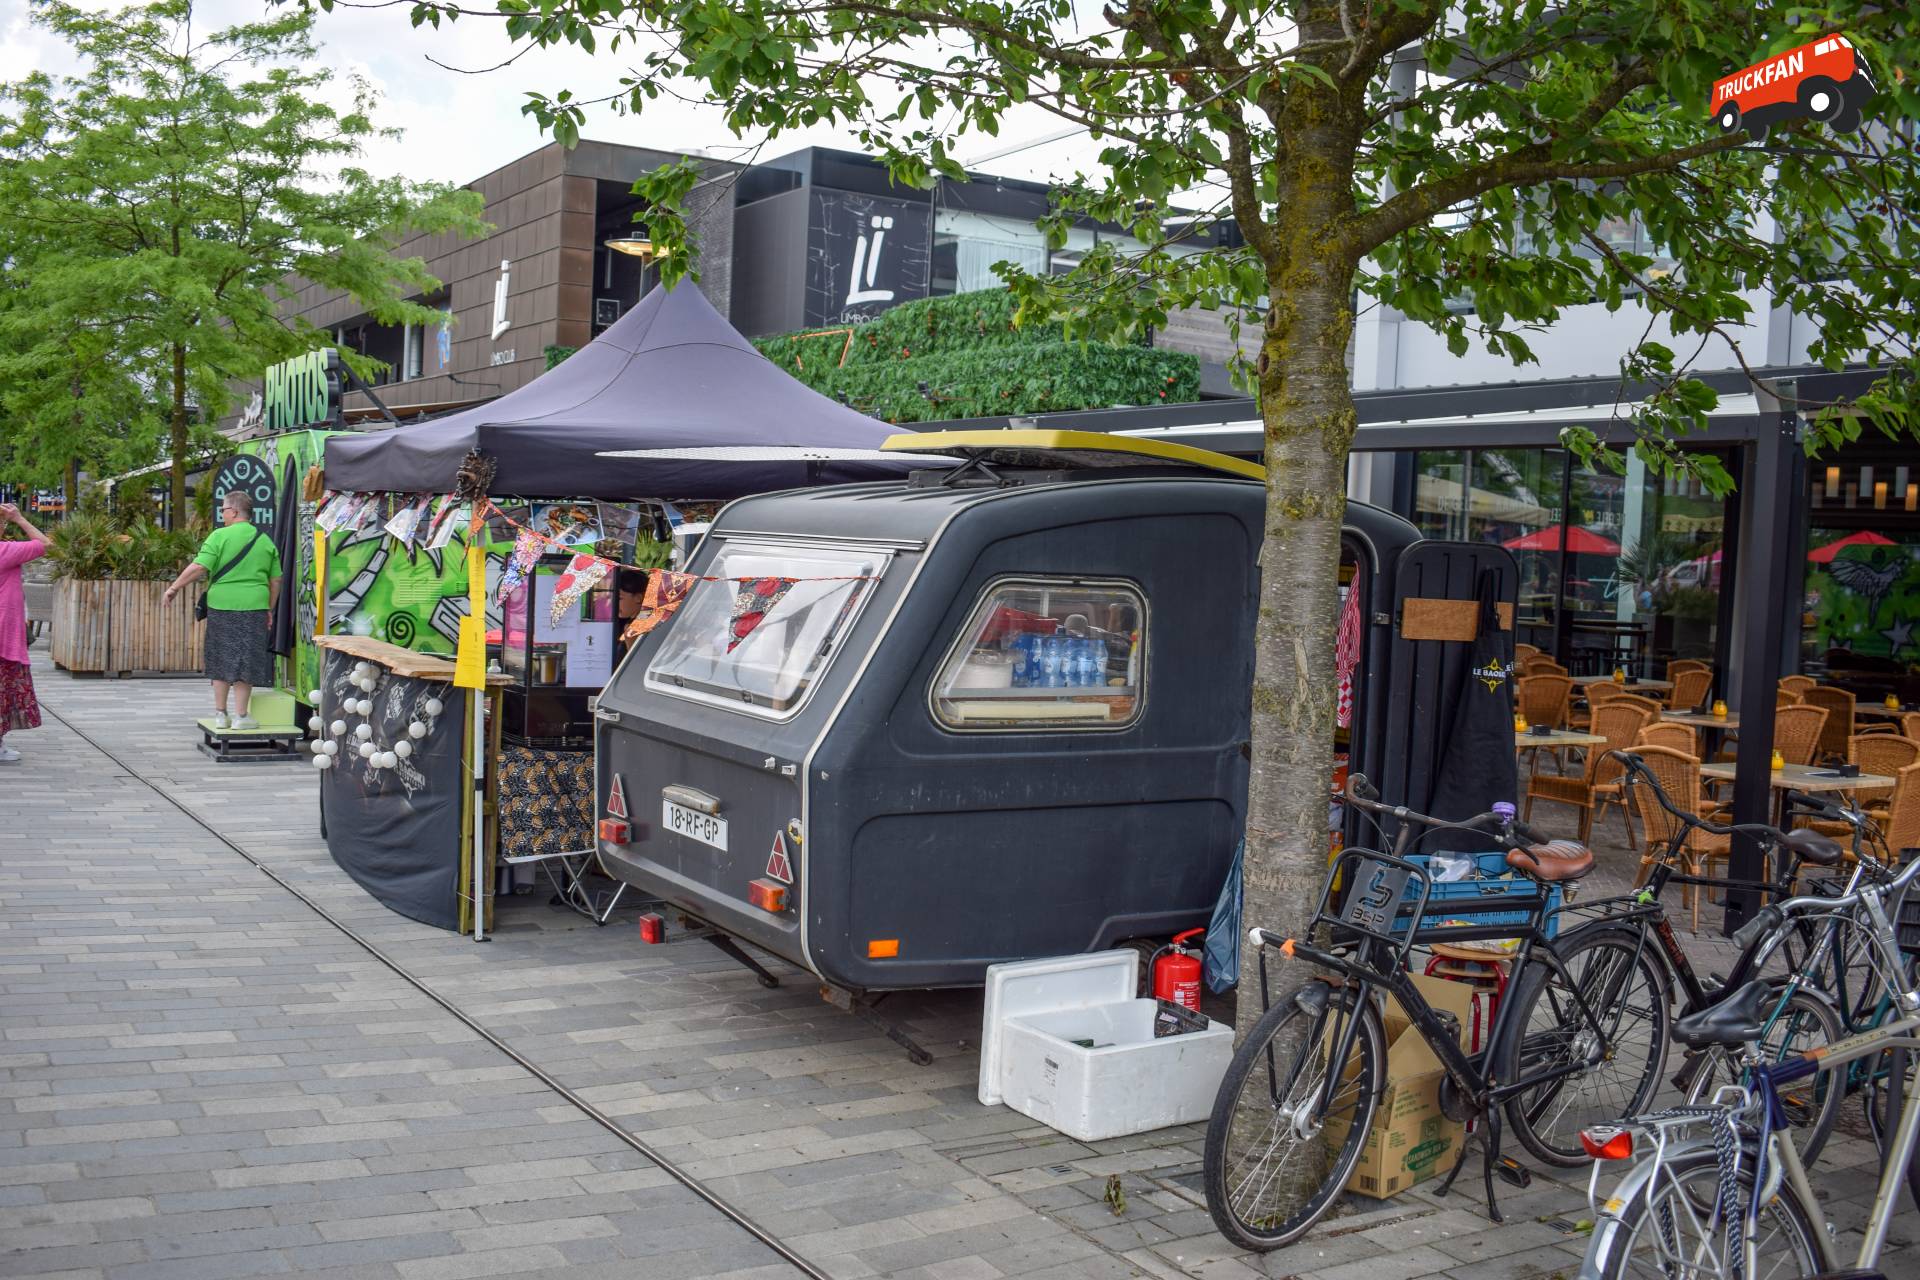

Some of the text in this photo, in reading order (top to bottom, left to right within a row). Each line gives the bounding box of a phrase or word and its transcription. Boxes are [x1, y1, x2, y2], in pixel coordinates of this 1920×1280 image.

[265, 347, 330, 431] PHOTOS
[215, 459, 272, 502] PHOTO
[216, 507, 273, 524] BTH
[671, 806, 719, 842] 18-RF-GP
